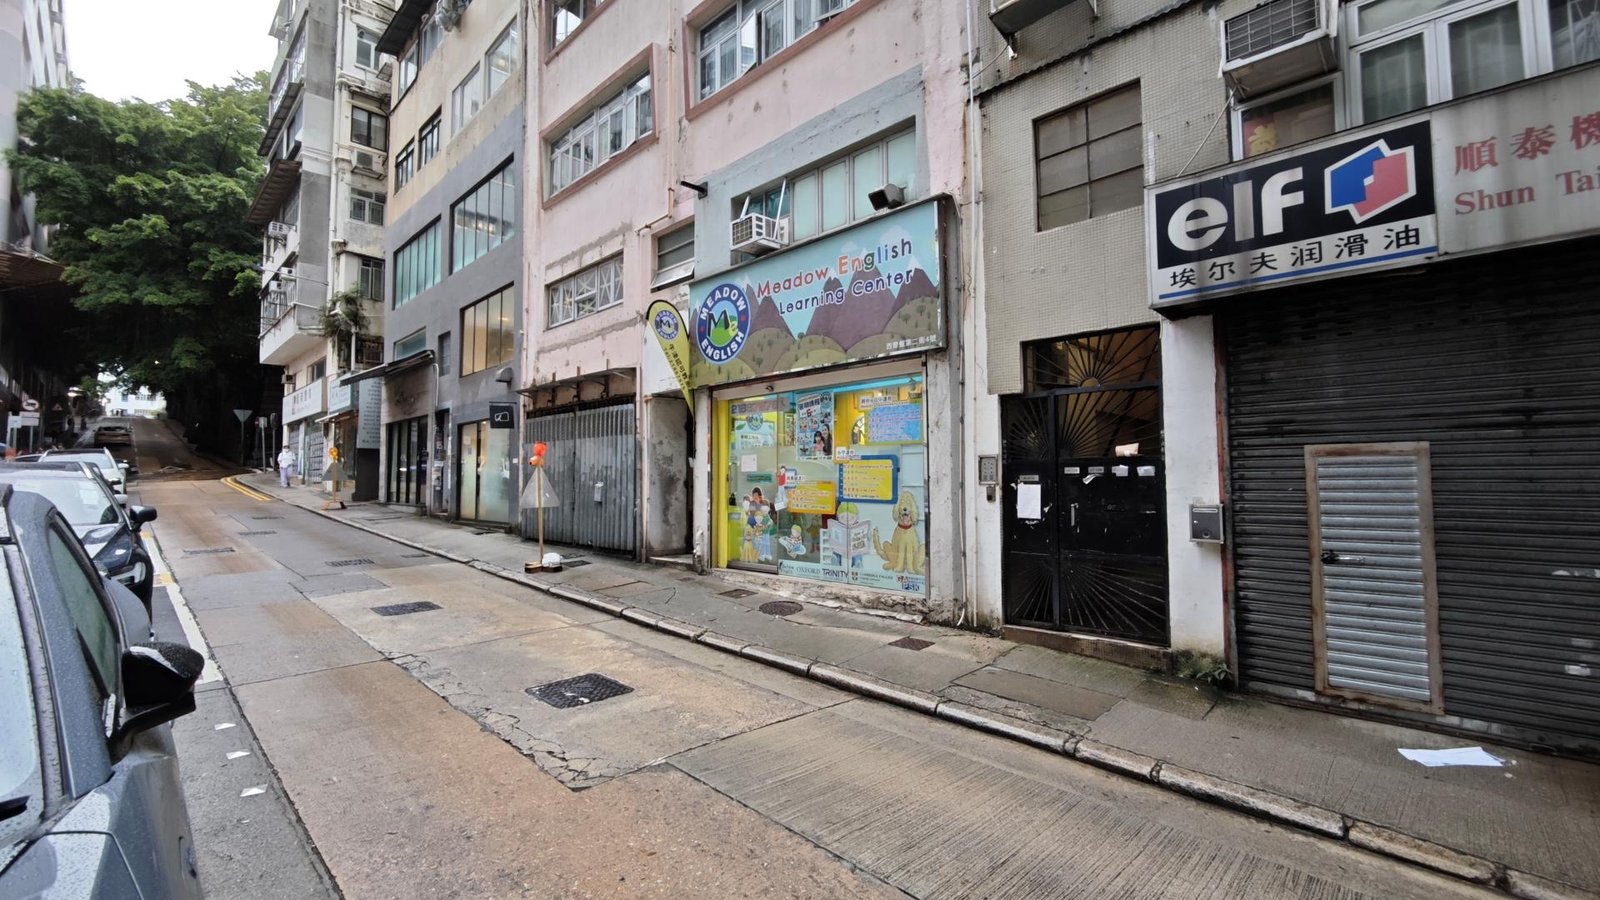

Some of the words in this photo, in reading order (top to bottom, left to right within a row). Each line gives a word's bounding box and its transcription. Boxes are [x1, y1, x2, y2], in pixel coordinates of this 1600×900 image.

[1167, 166, 1305, 252] elf
[1455, 186, 1536, 215] Shun
[757, 265, 829, 298] Meadow
[837, 238, 912, 278] English
[1169, 224, 1421, 289] 埃尔夫润滑油
[700, 286, 747, 321] MEADOW
[778, 287, 845, 315] Learning
[852, 269, 913, 297] Center
[701, 330, 745, 360] ENGLISH
[822, 567, 849, 580] TRINITY
